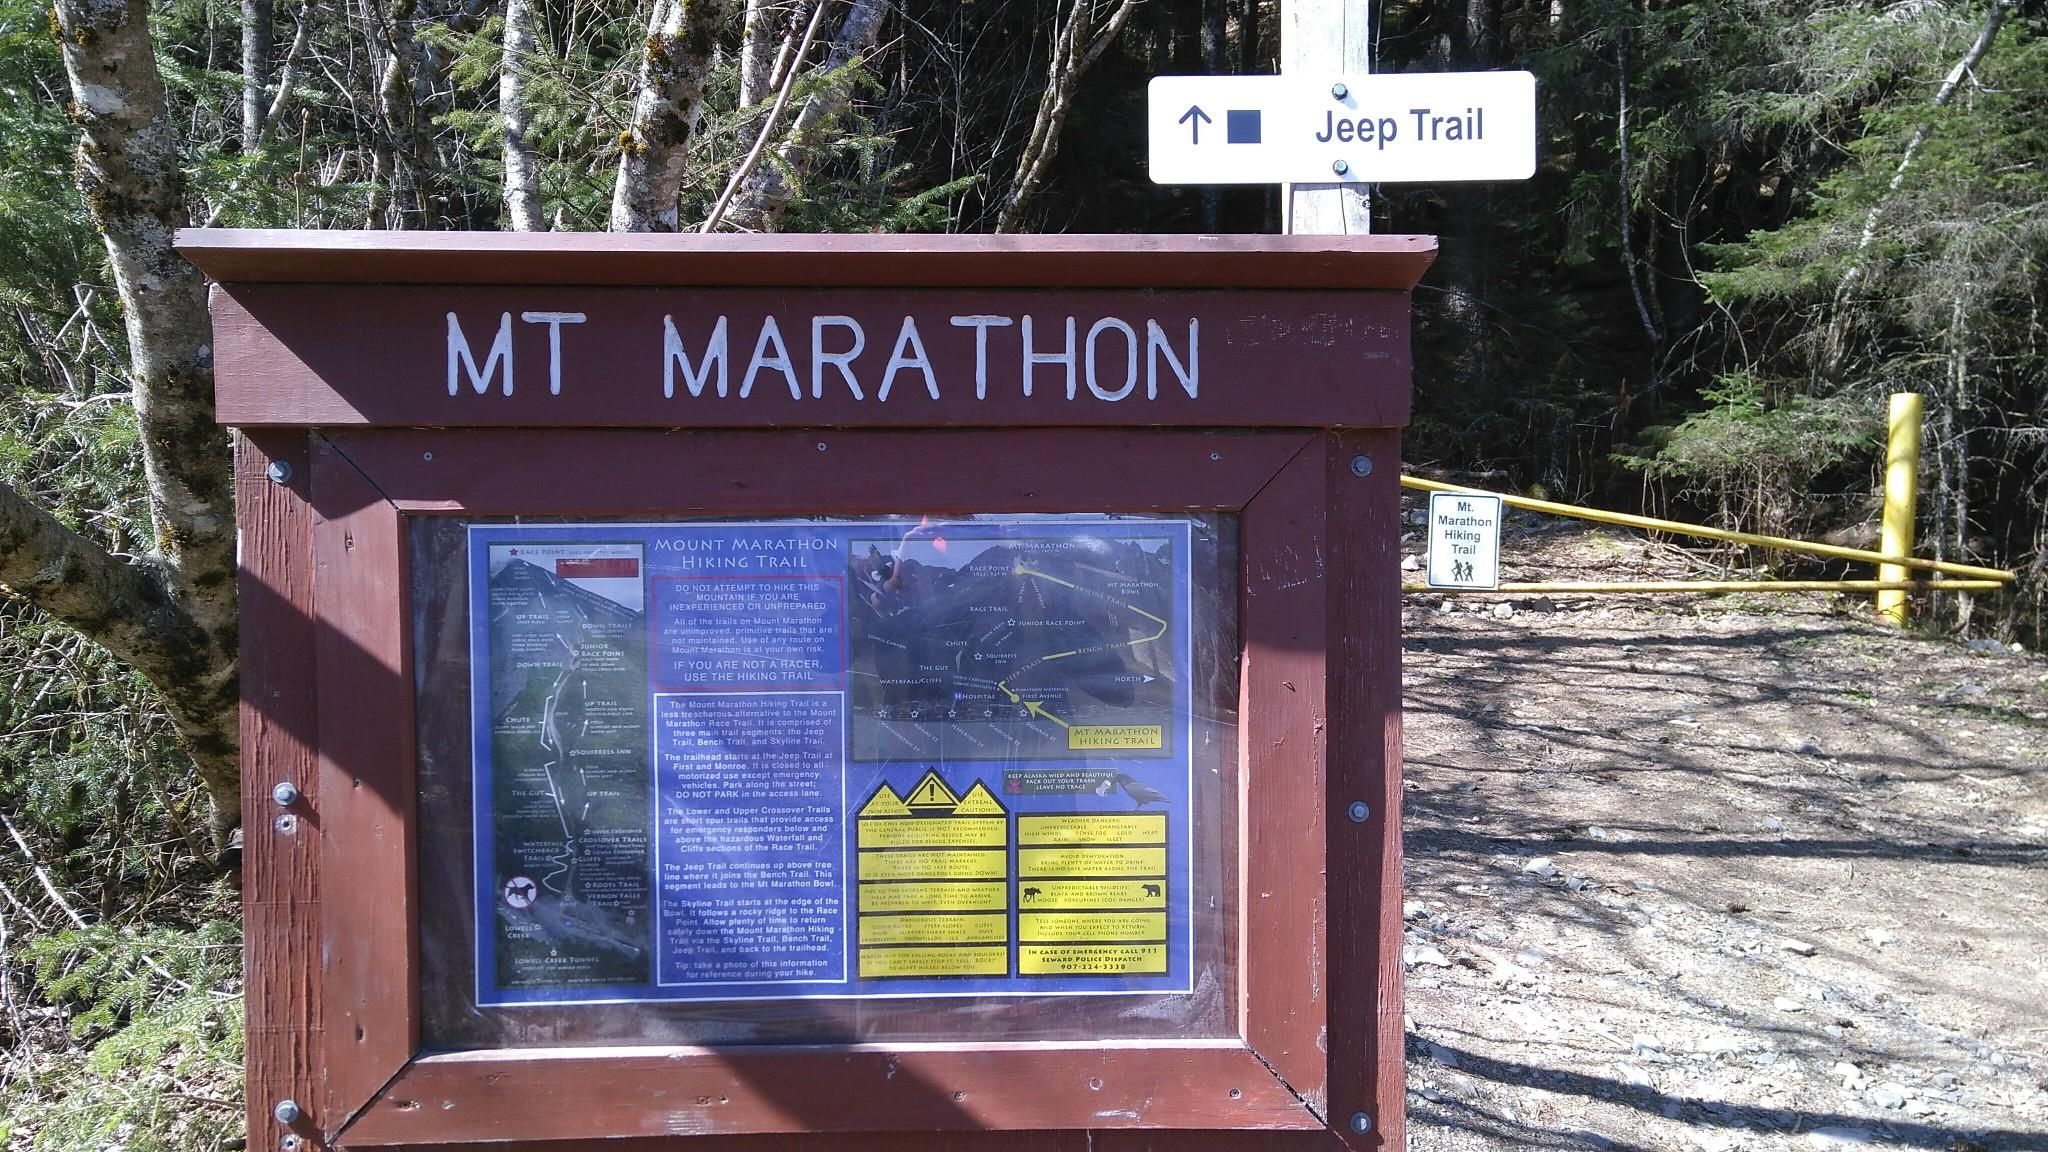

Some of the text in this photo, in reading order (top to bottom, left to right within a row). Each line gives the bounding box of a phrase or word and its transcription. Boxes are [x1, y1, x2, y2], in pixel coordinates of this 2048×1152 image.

[1316, 108, 1483, 150] Jeep Trail
[447, 311, 586, 397] MT
[664, 314, 1200, 400] MARATHON
[1438, 515, 1492, 526] Marathon
[1445, 530, 1480, 543] Hiking
[655, 538, 837, 550] MOUNT MARATHON
[1452, 544, 1475, 554] Trail
[682, 555, 806, 568] HIKING TRAIL
[674, 661, 683, 669] IF
[688, 661, 712, 669] YOU
[715, 660, 738, 669] ARE
[742, 660, 766, 669] NOT
[769, 660, 779, 668] A
[684, 671, 813, 681] USE THE HIKING TRAIL
[779, 753, 799, 761] Jeep
[741, 772, 770, 780] except
[745, 781, 769, 789] along
